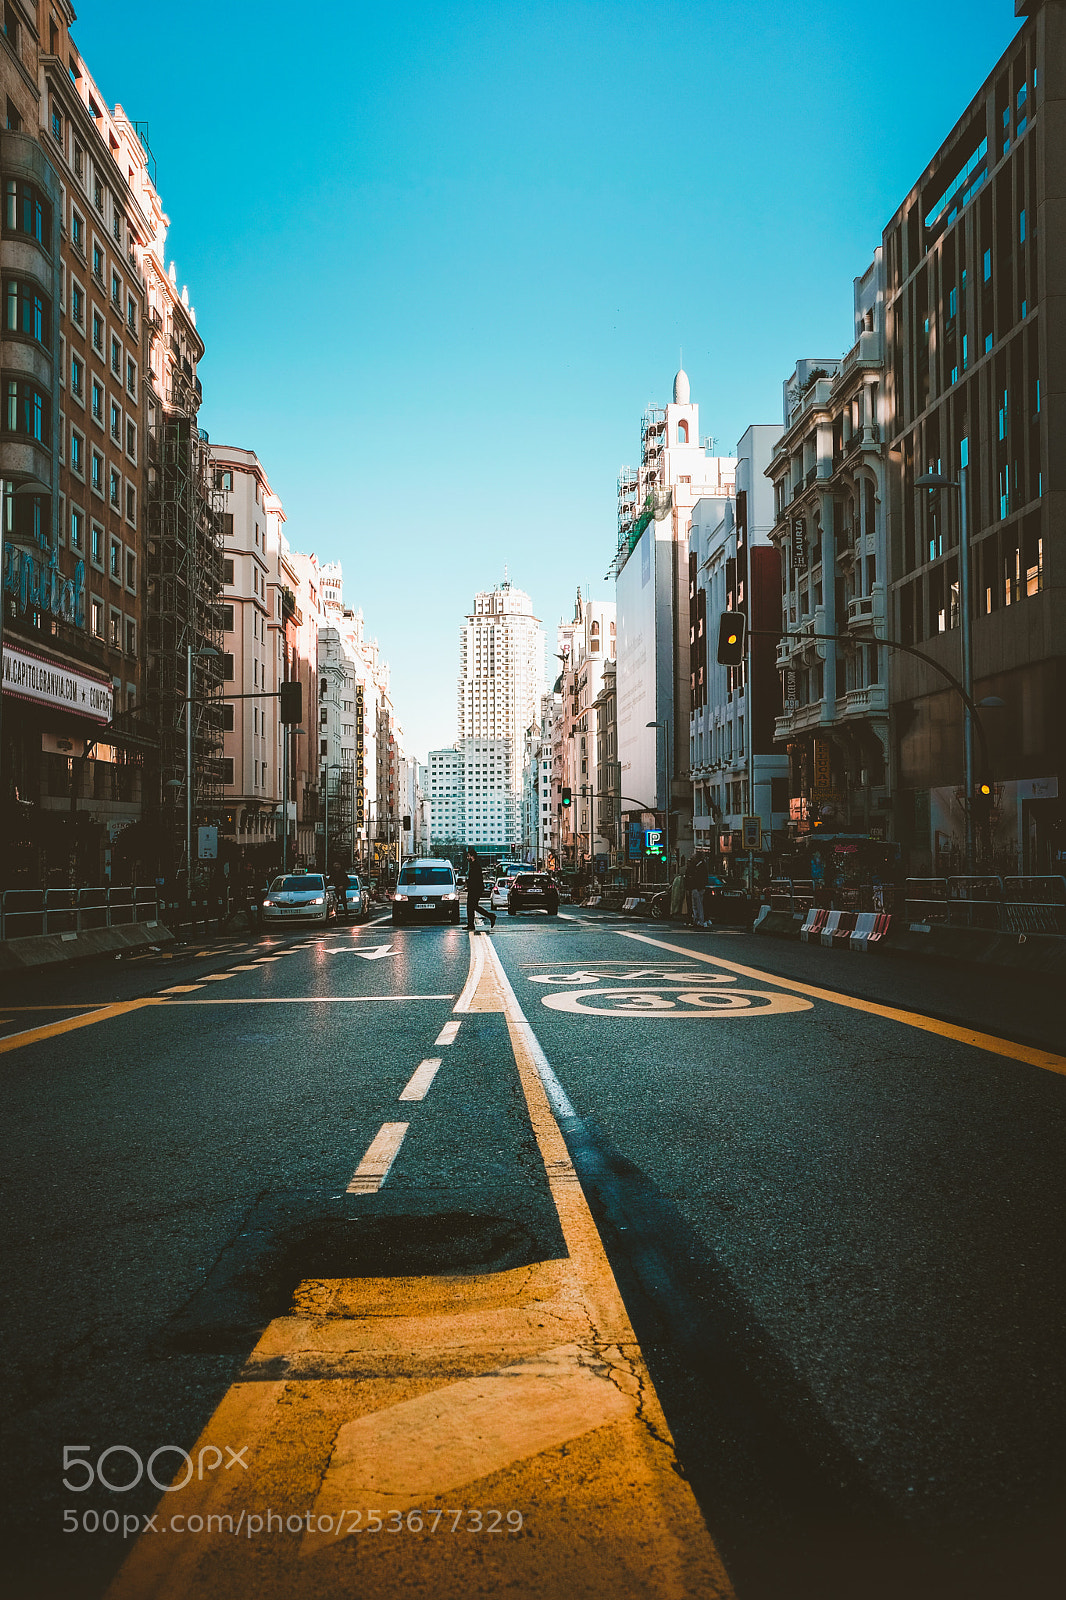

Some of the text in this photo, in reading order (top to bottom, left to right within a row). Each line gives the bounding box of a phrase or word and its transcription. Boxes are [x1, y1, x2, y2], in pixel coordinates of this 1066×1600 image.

[795, 519, 803, 556] LAURIA
[356, 685, 364, 828] HOTEL EMPERADOR
[649, 832, 661, 846] P
[604, 992, 752, 1009] 30
